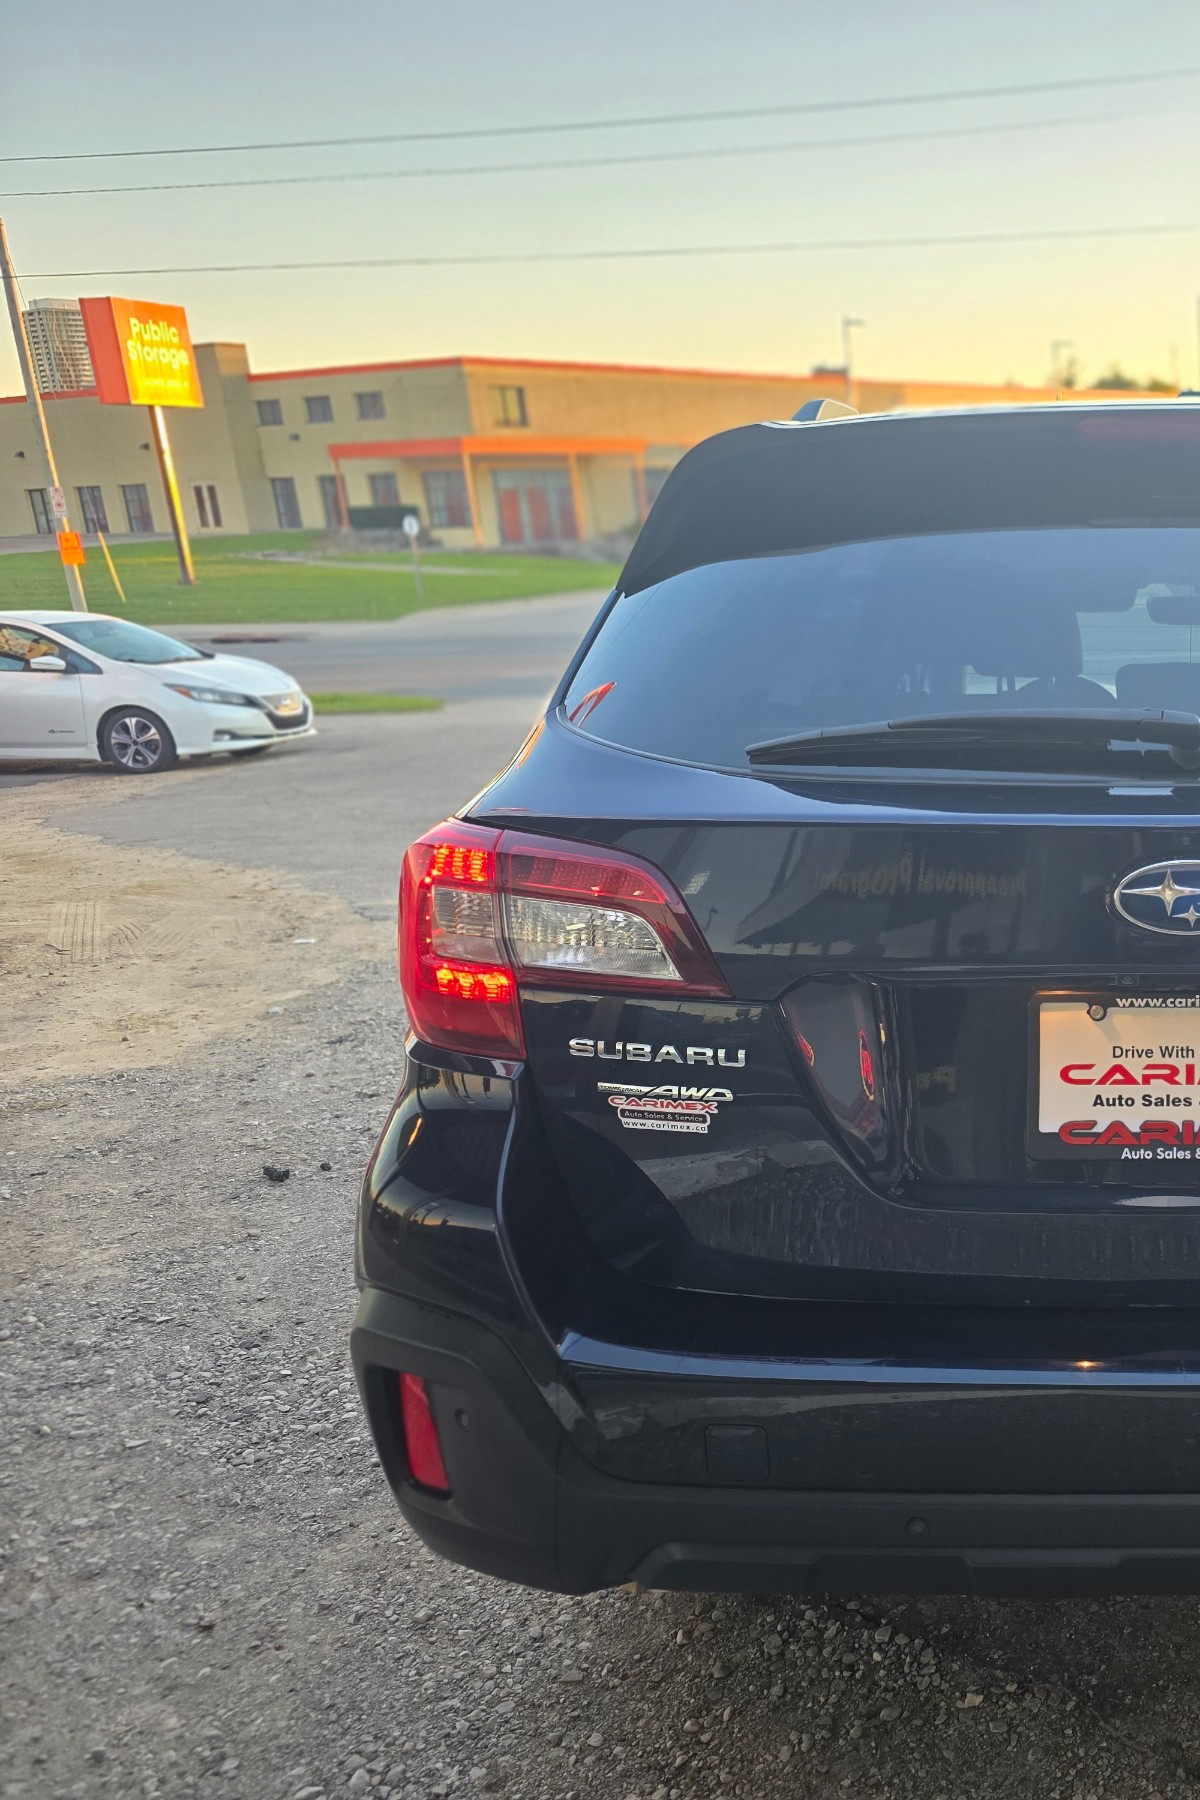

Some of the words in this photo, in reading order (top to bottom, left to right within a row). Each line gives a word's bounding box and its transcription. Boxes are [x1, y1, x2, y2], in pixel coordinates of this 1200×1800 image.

[129, 317, 179, 343] Public
[126, 339, 189, 370] Storage
[569, 1037, 746, 1067] SUBARU
[1112, 1046, 1154, 1059] Drive
[1159, 1046, 1195, 1059] With
[647, 1085, 733, 1101] AWD
[609, 1097, 716, 1112] CARIMEX
[1092, 1094, 1135, 1107] Auto
[1141, 1094, 1193, 1107] Sales
[624, 1110, 642, 1118] Auto
[644, 1112, 665, 1120] Sales
[675, 1114, 704, 1123] Service
[623, 1120, 707, 1132] www.carimex.ca
[1121, 1148, 1152, 1160] Auto
[1156, 1148, 1191, 1160] Sales
